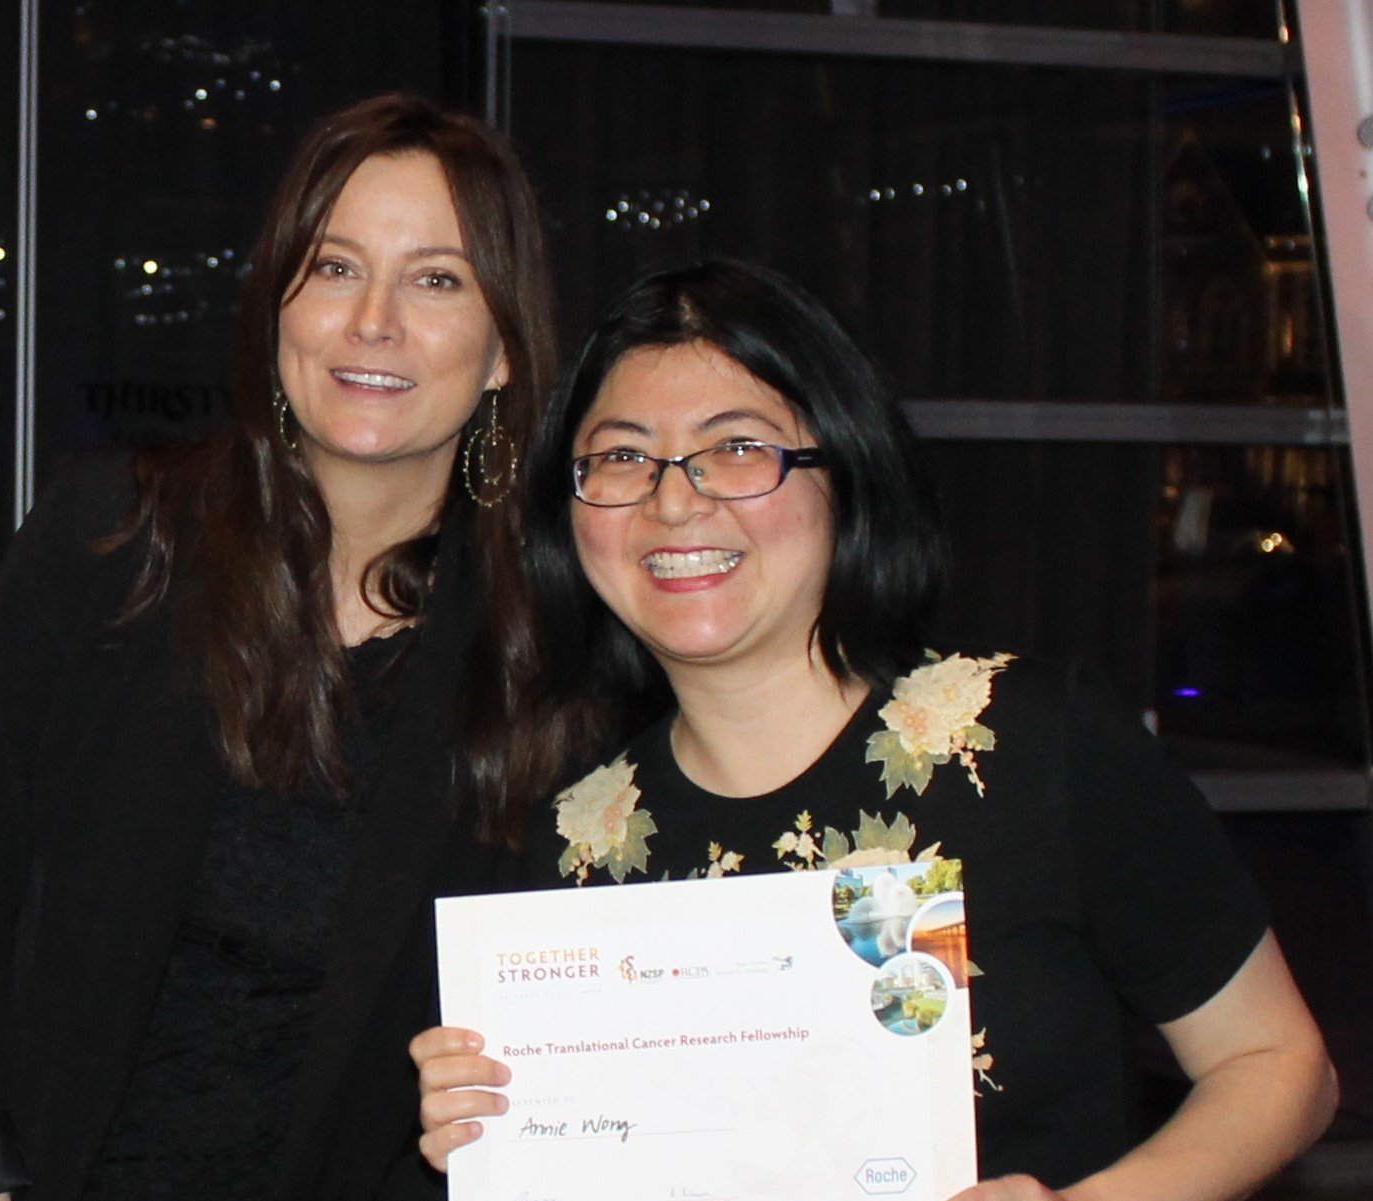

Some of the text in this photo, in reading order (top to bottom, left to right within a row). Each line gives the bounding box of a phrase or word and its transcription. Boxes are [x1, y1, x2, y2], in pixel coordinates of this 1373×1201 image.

[496, 947, 600, 966] TOGETHER
[497, 964, 600, 984] STRONGER
[640, 969, 665, 979] NZSP
[503, 1027, 810, 1057] Roche Translational Cancer Research Fellowship
[511, 1096, 560, 1106] RESENTED
[519, 1114, 637, 1143] Annie Wong
[865, 1167, 908, 1185] Roche
